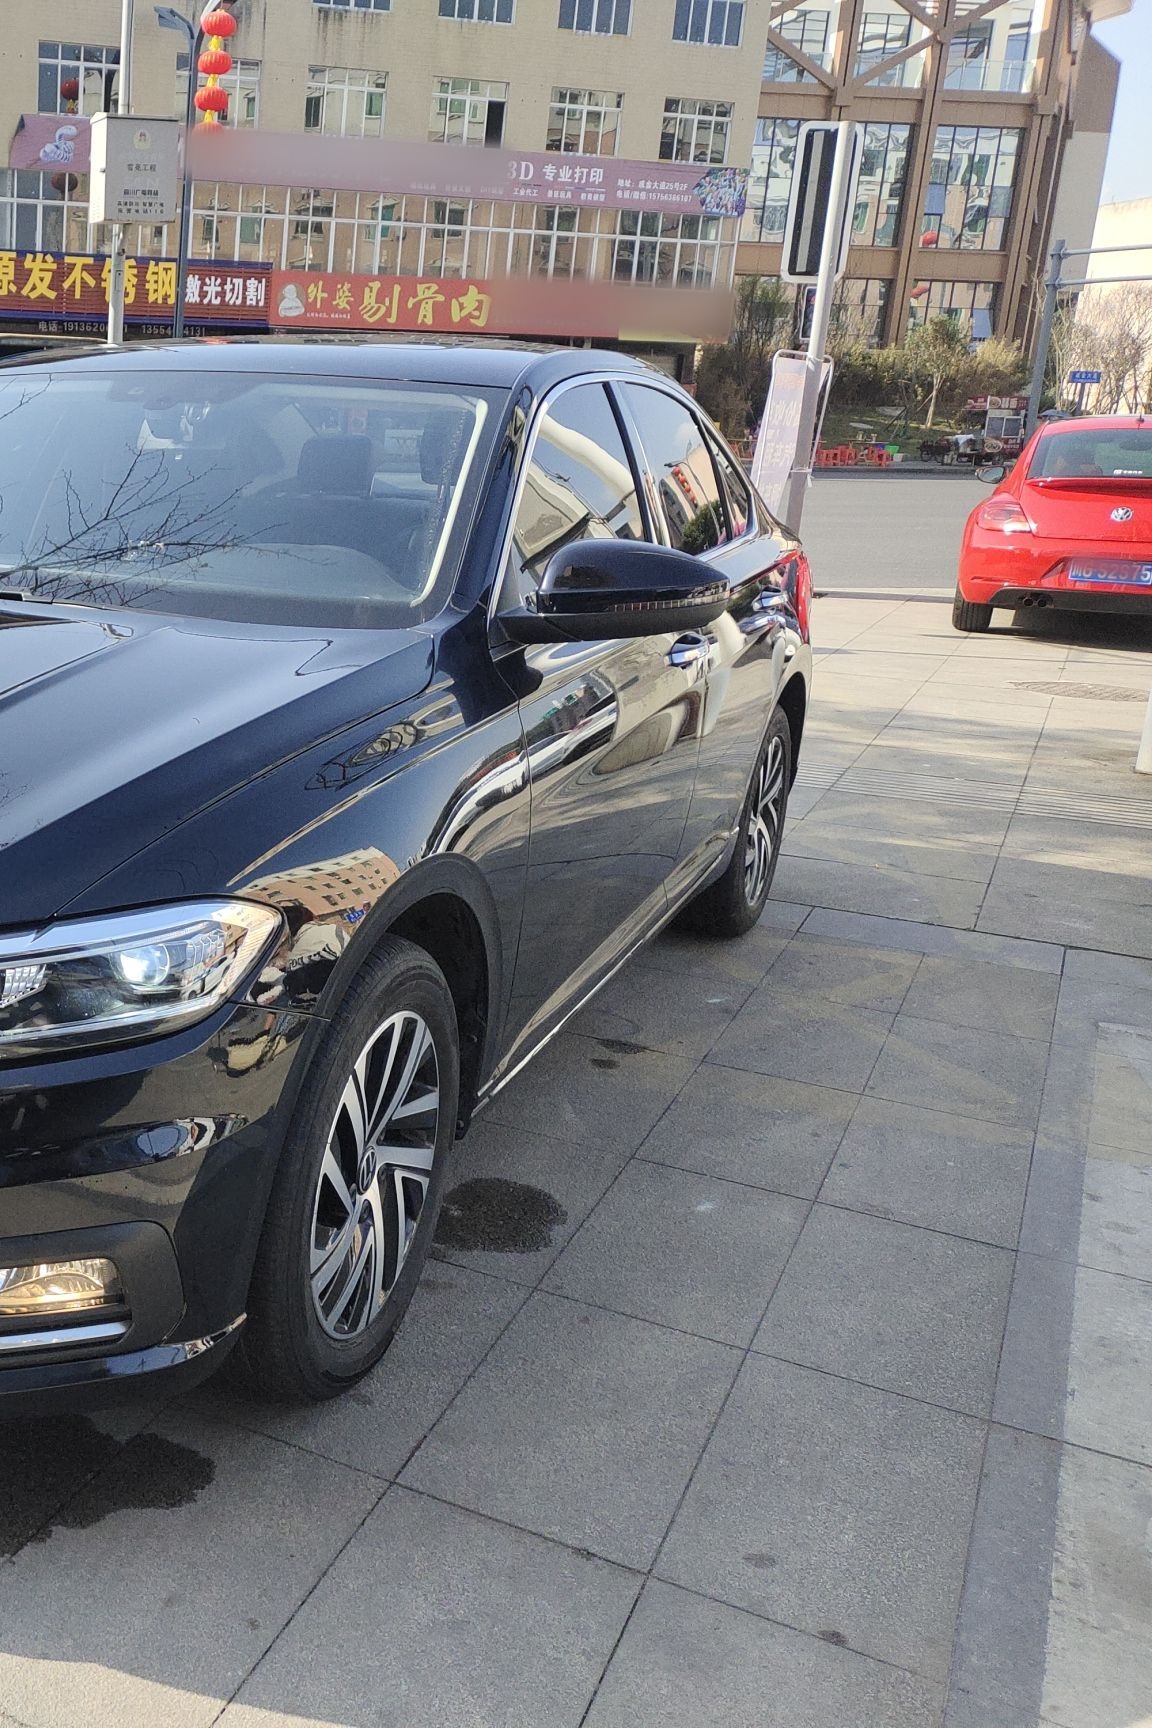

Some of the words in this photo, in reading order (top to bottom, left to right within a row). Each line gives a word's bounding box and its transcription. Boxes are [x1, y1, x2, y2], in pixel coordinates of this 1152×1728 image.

[507, 160, 534, 180] 3D
[542, 163, 604, 185] 专业打印
